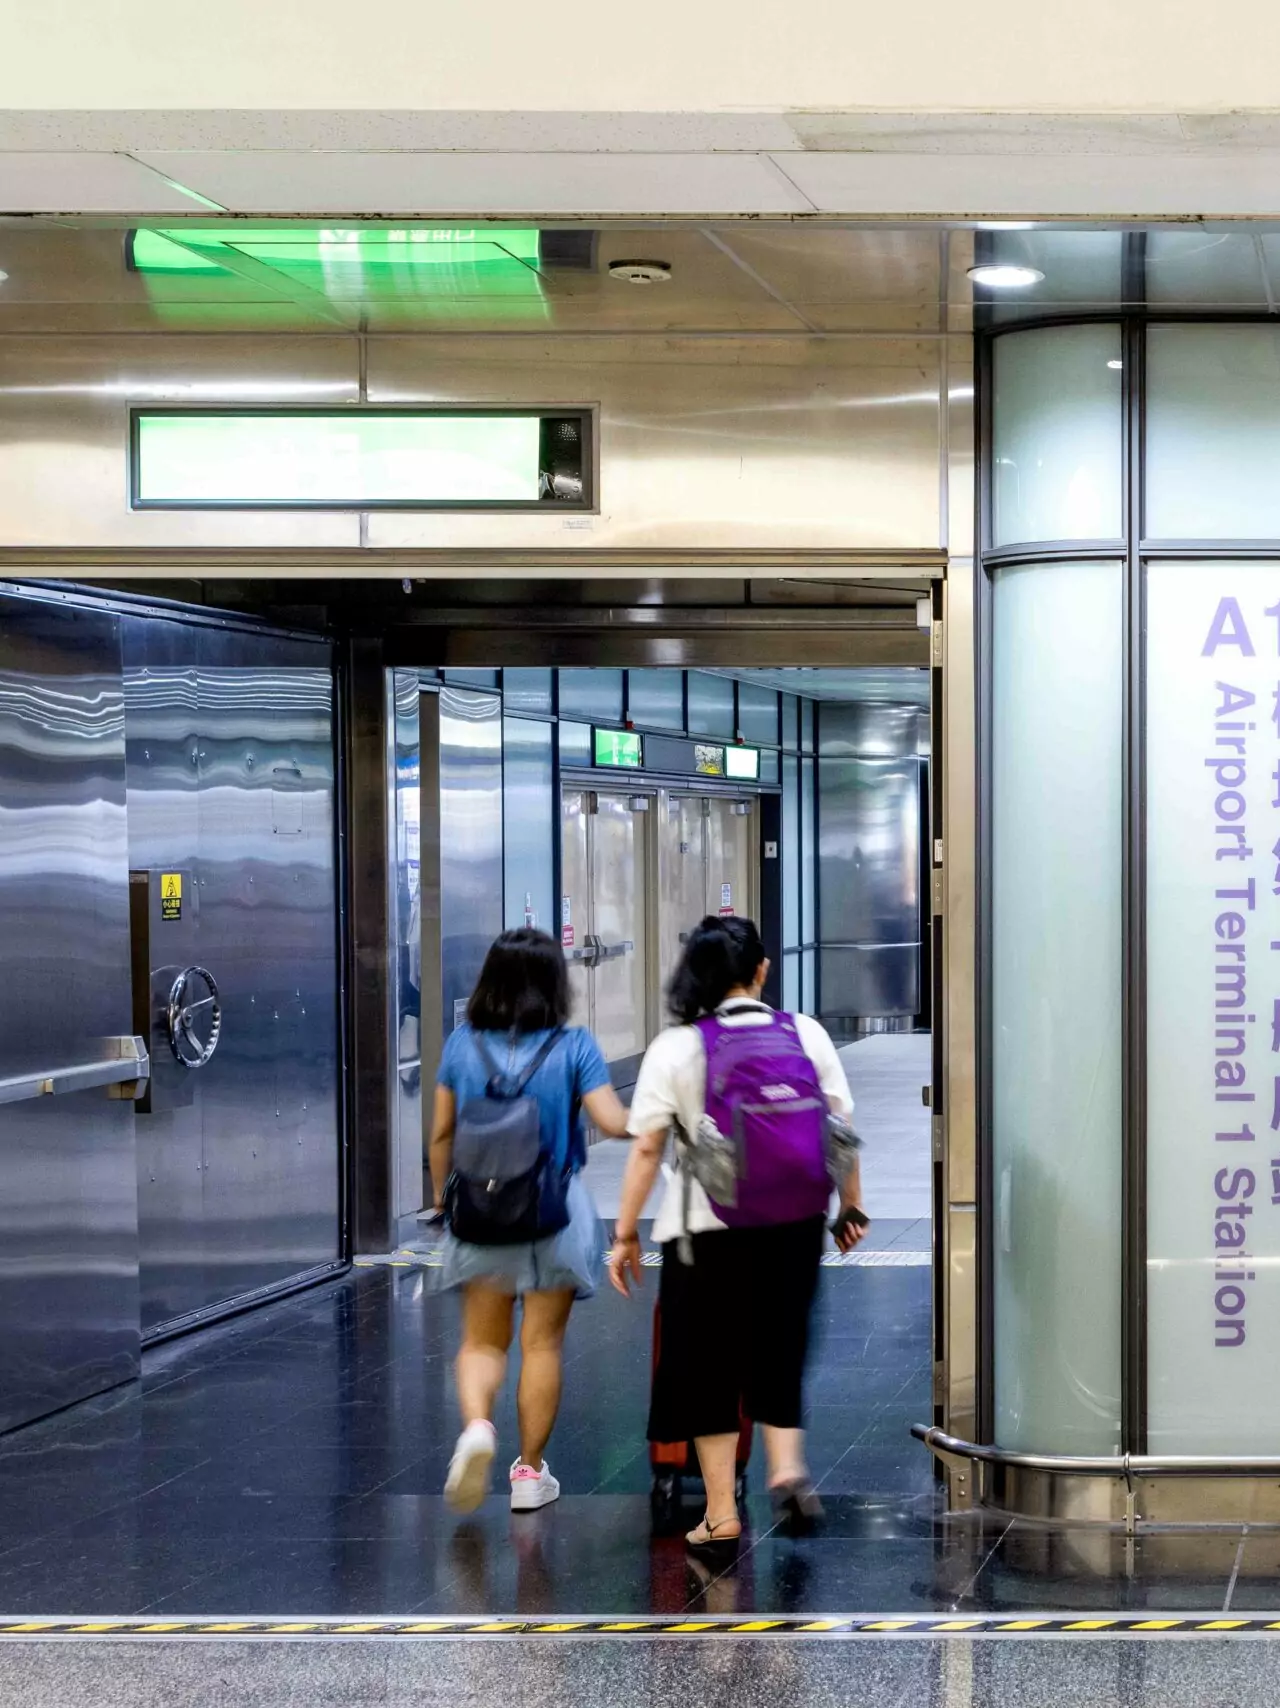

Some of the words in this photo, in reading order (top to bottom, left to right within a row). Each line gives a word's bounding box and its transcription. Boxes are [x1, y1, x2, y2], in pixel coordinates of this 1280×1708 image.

[1204, 680, 1256, 861] Airport
[1214, 878, 1256, 1102] Terminal
[1214, 1123, 1256, 1142] 1
[1214, 1168, 1256, 1348] Station
